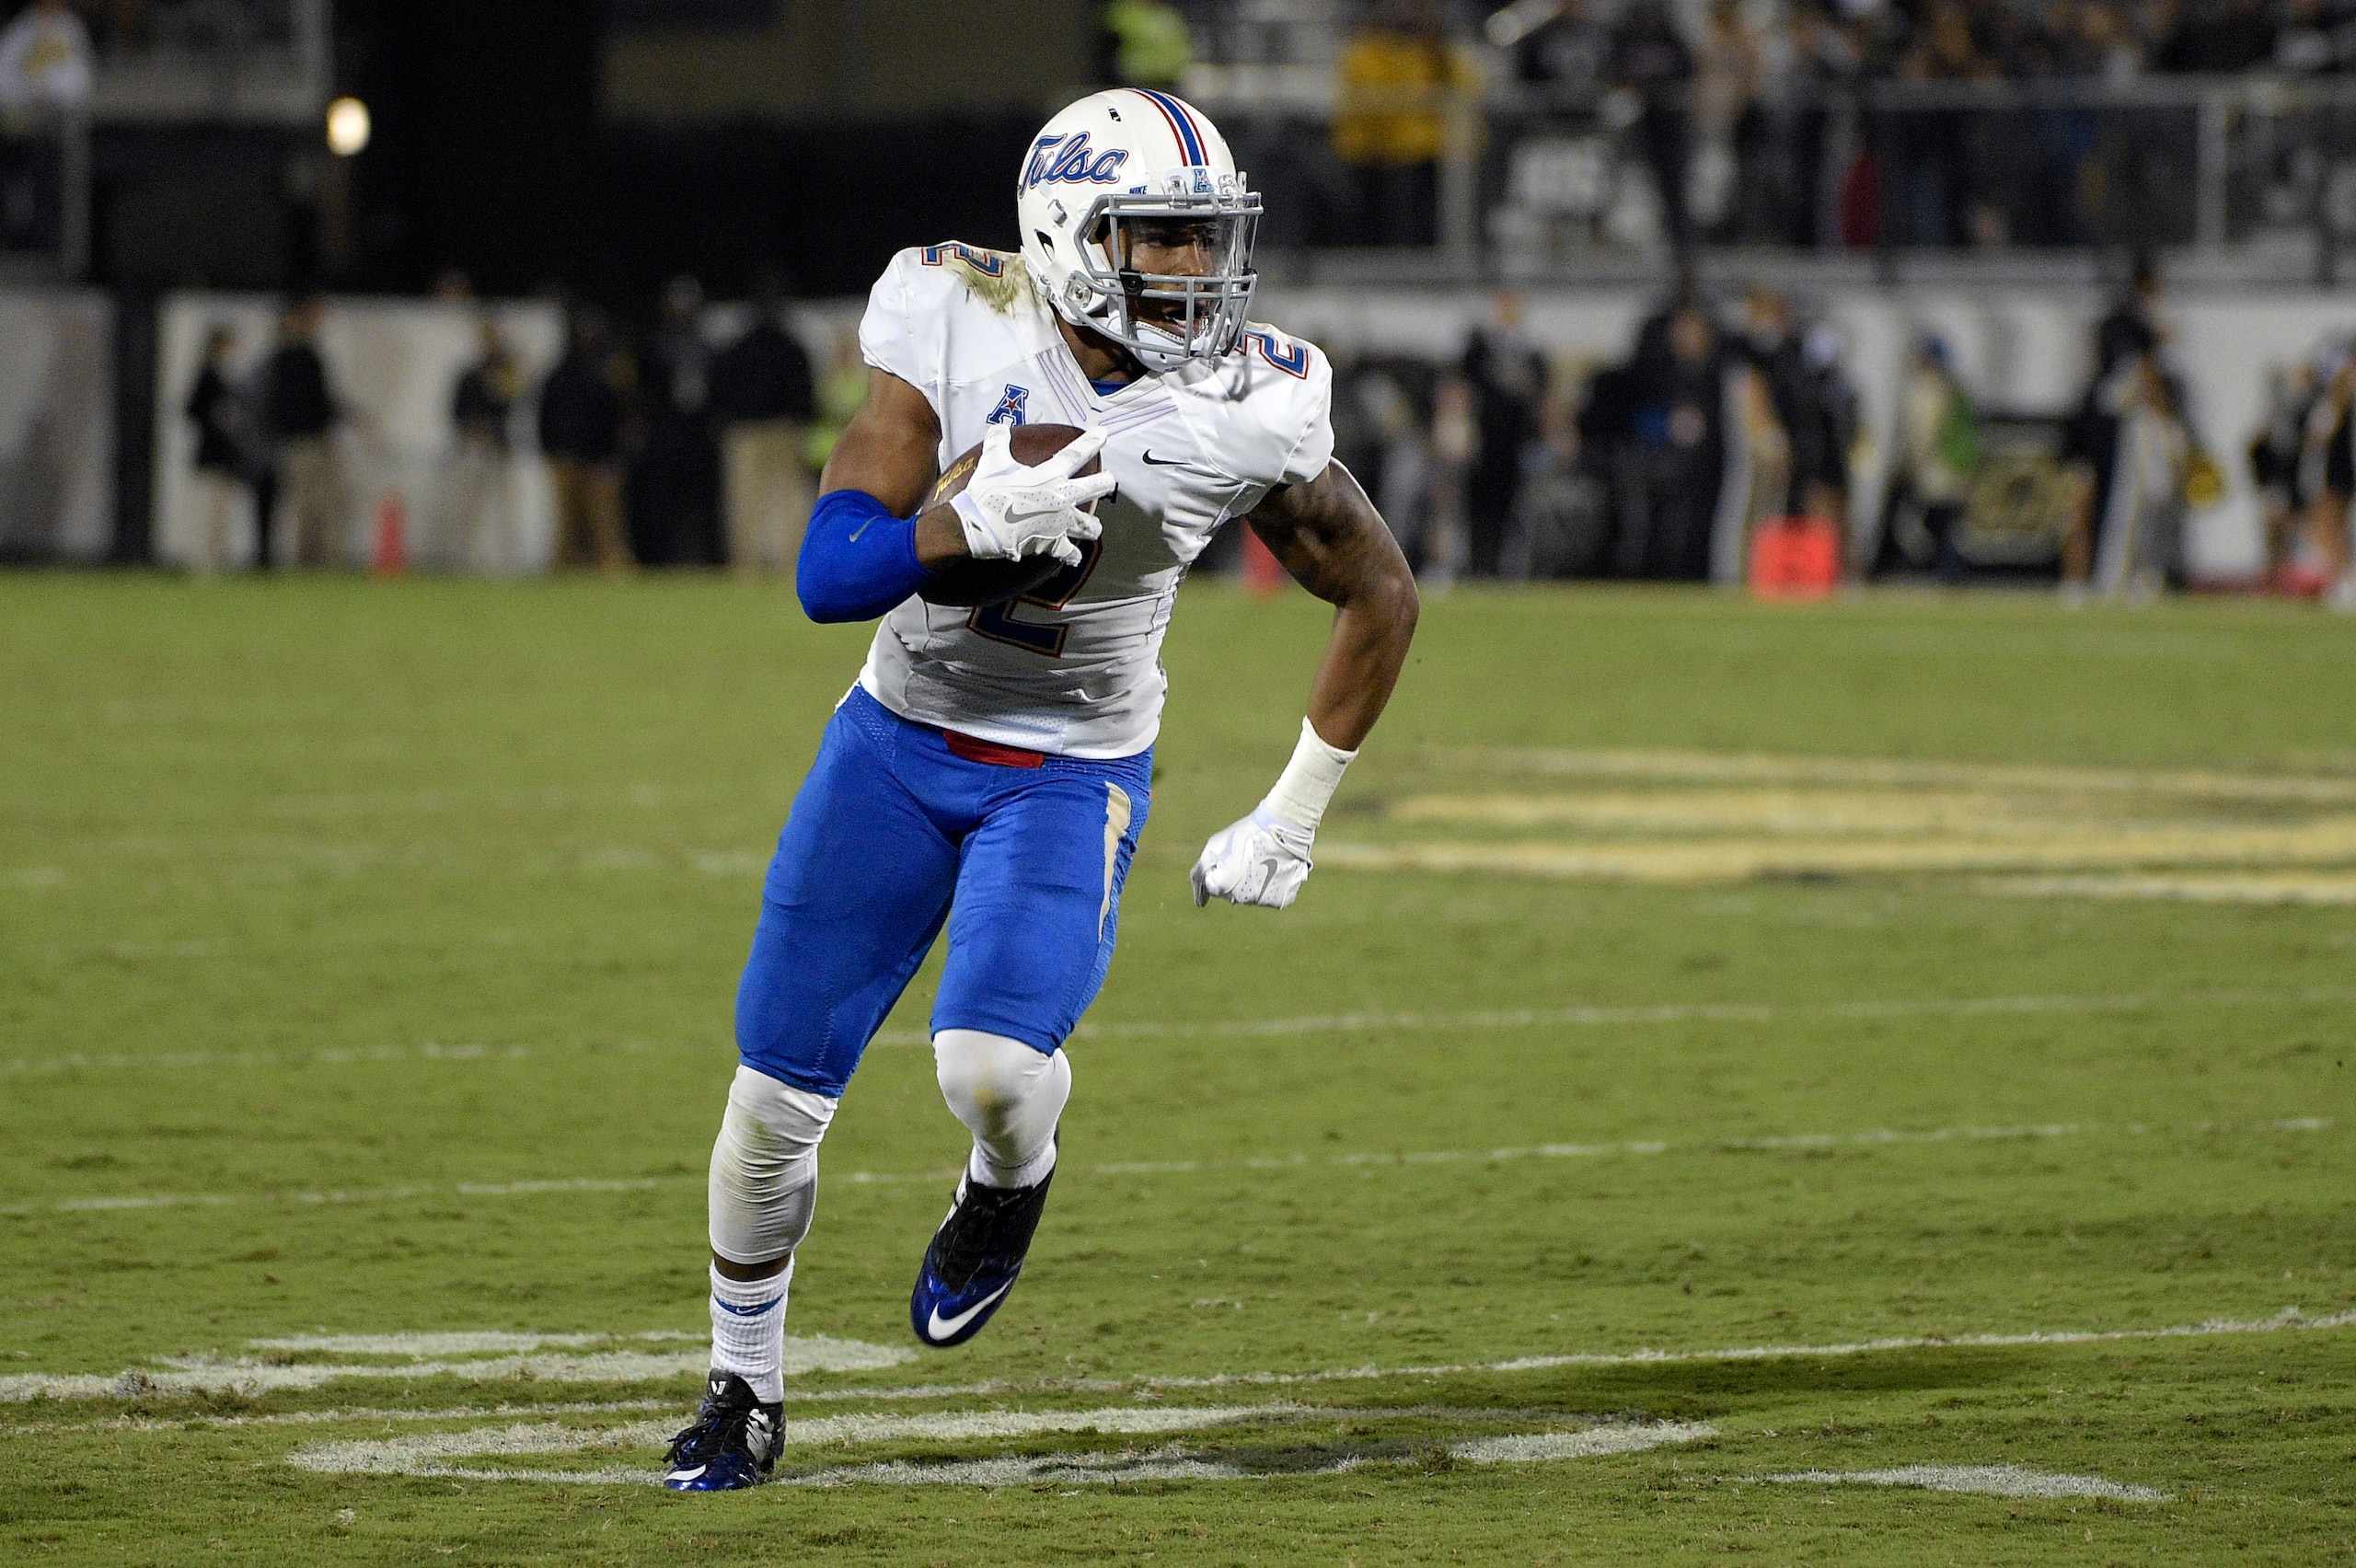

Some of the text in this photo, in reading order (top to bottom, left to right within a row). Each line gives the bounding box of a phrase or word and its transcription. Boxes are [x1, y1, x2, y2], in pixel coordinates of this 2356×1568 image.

[1019, 132, 1128, 199] Tulsa
[921, 243, 1004, 277] 2
[1228, 326, 1309, 380] 2
[986, 384, 1029, 426] A
[933, 457, 975, 502] Tulsa
